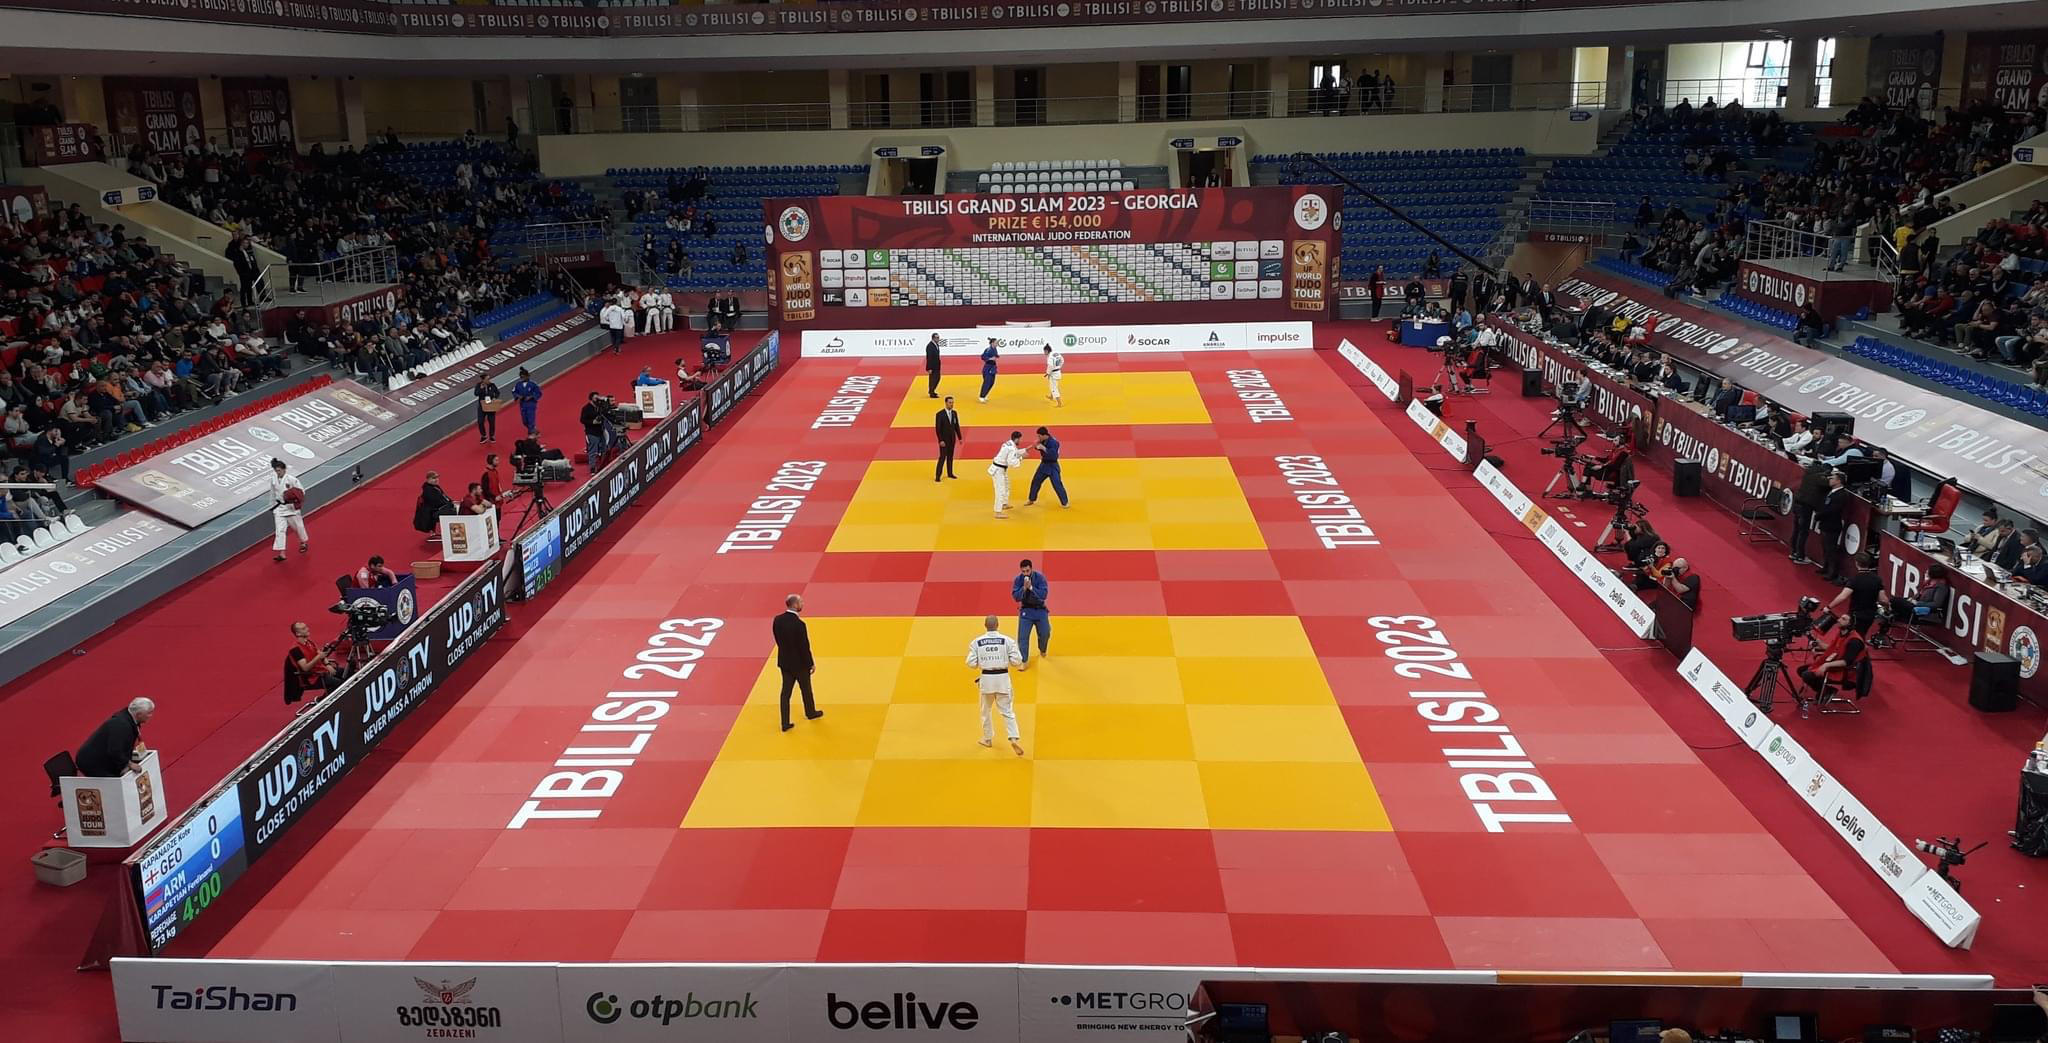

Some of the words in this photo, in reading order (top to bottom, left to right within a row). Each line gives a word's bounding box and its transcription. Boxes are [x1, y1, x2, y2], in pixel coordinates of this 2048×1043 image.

[402, 14, 448, 26] TBILISI
[479, 14, 524, 26] TBILISI
[552, 15, 596, 28] TBILISI
[624, 15, 671, 28] TBILISI
[702, 13, 748, 25] TBILISI
[780, 11, 826, 24] TBILISI
[856, 9, 902, 22] TBILISI
[932, 7, 978, 20] TBILISI
[1008, 5, 1054, 18] TBILISI
[1085, 2, 1130, 15] TBILISI
[1161, 0, 1208, 12] TBILISI
[1888, 72, 1917, 86] GRAND
[1996, 70, 2032, 86] GRAND
[142, 90, 175, 109] TBILISI
[146, 112, 178, 128] GRAND
[250, 110, 275, 124] GRAND
[148, 130, 181, 152] SLAM
[251, 125, 278, 144] SLAM
[902, 200, 952, 214] TBILISI
[957, 199, 1016, 214] GRAND
[1020, 197, 1063, 212] SLAM
[1067, 196, 1106, 212] 2023
[1124, 193, 1198, 210] GEORGIA
[972, 232, 1046, 242] INTERNATIONAL
[1048, 231, 1072, 241] JUDO
[1074, 230, 1131, 240] FEDERATION
[988, 216, 1028, 229] PRIZE
[1032, 216, 1041, 228] €
[1045, 214, 1102, 230] 154,000
[786, 282, 811, 290] WORLD
[1294, 280, 1322, 289] JUDO
[1296, 272, 1322, 280] WORLD
[1760, 274, 1793, 302] TBILISI
[786, 290, 811, 300] JUDO
[786, 299, 812, 309] TOUR
[1294, 289, 1321, 298] TOUR
[786, 311, 812, 320] TBILISI
[1138, 338, 1170, 346] SOCAR
[1257, 332, 1300, 342] impulse
[1225, 368, 1272, 388] 2023
[1502, 332, 1528, 367] TBILISI
[1592, 384, 1630, 424] TBILISI
[1236, 390, 1294, 424] TBILISI
[1666, 322, 1726, 349] TBILISI
[1734, 348, 1804, 380] TBILISI
[1818, 382, 1904, 422] TBILISI
[1928, 424, 2038, 474] TBILISI
[270, 399, 344, 432] TBILISI
[810, 396, 870, 430] TBILISI
[308, 422, 340, 442] GRAND
[170, 436, 257, 475] TBILISI
[1672, 428, 1709, 467] TBILISI
[1728, 459, 1772, 502] TBILISI
[212, 466, 254, 488] GRAND
[1274, 455, 1338, 486] 2023
[716, 495, 806, 554] TBILISI
[765, 460, 828, 491] 2023
[1294, 490, 1381, 550] TBILISI
[84, 527, 149, 557] TBILISI
[0, 570, 58, 604] BILISI
[1608, 587, 1626, 608] belive
[447, 648, 465, 666] CLOSE
[464, 637, 473, 654] TO
[472, 628, 483, 646] THE
[482, 608, 501, 634] ACTION
[1367, 615, 1473, 680] 2023
[363, 714, 387, 744] NEVER
[387, 702, 404, 723] MISS
[403, 695, 410, 709] A
[408, 672, 433, 698] THROW
[506, 690, 680, 830] TBILISI
[622, 617, 725, 680] 2023
[1408, 691, 1573, 833] TBILISI
[256, 811, 286, 845] CLOSE
[284, 797, 298, 819] TO
[297, 782, 316, 808] THE
[314, 752, 346, 787] ACTION
[1835, 805, 1866, 842] belive
[142, 838, 178, 870] KAPANADZE
[178, 828, 191, 841] Kote
[160, 847, 182, 875] GEO
[208, 815, 217, 836] 0
[163, 870, 186, 901] ARM
[211, 838, 220, 859] 0
[148, 886, 188, 924] KARAPETIAN
[150, 910, 178, 940] REPECHAGE
[182, 871, 222, 921] 4:00
[1930, 888, 1964, 923] METGROUP
[152, 932, 166, 950] -73
[166, 926, 176, 940] kg
[151, 985, 296, 1011] TaiShan
[630, 992, 760, 1026] otpbank
[827, 992, 979, 1030] belive
[396, 1006, 502, 1028] ზედაზენი
[426, 1028, 476, 1038] ZEDAZENI
